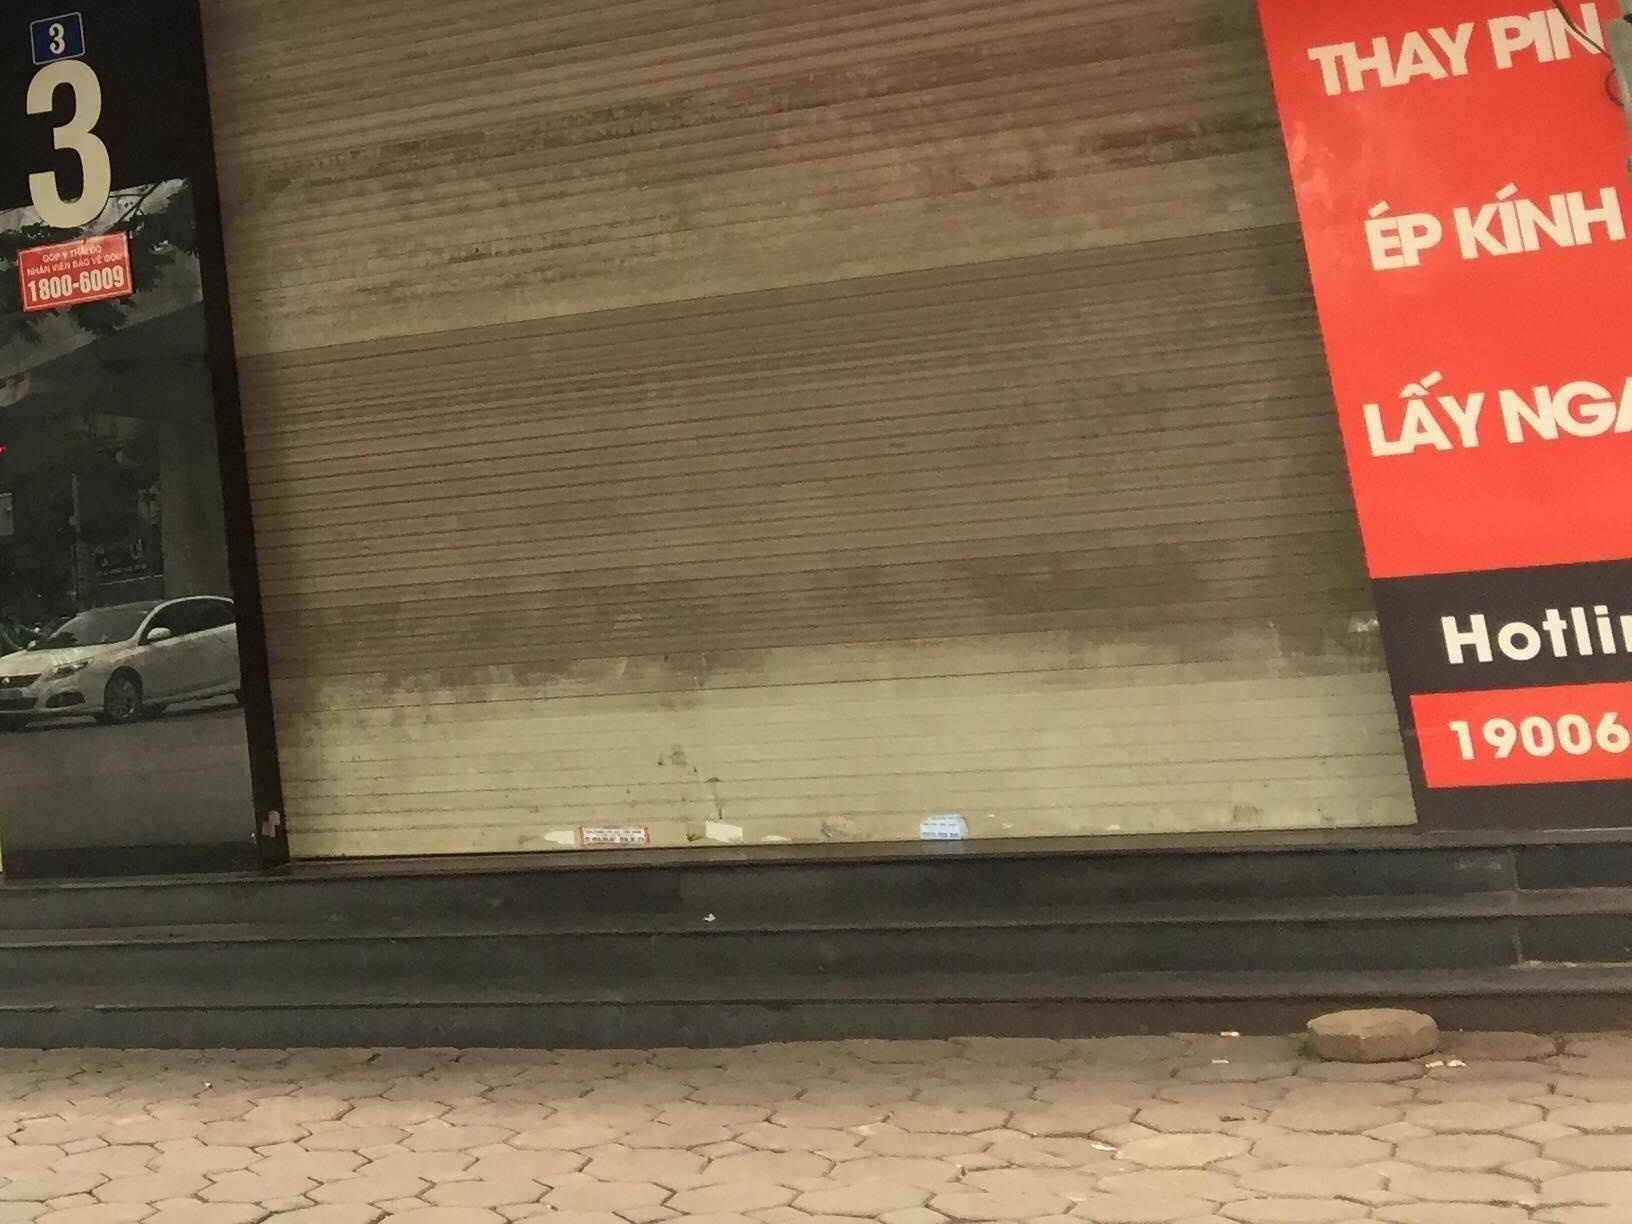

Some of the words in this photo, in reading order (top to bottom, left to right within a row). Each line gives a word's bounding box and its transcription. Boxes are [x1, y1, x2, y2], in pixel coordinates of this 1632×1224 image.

[48, 22, 66, 55] 3
[1307, 22, 1474, 96] THAY
[1487, 2, 1605, 70] PIN
[26, 59, 112, 229] 3
[1364, 200, 1443, 271] ÉP
[1453, 182, 1626, 261] KÍNH
[27, 265, 124, 303] 1800-6009
[1363, 371, 1485, 457] LẤY
[1449, 712, 1631, 761] 19006
